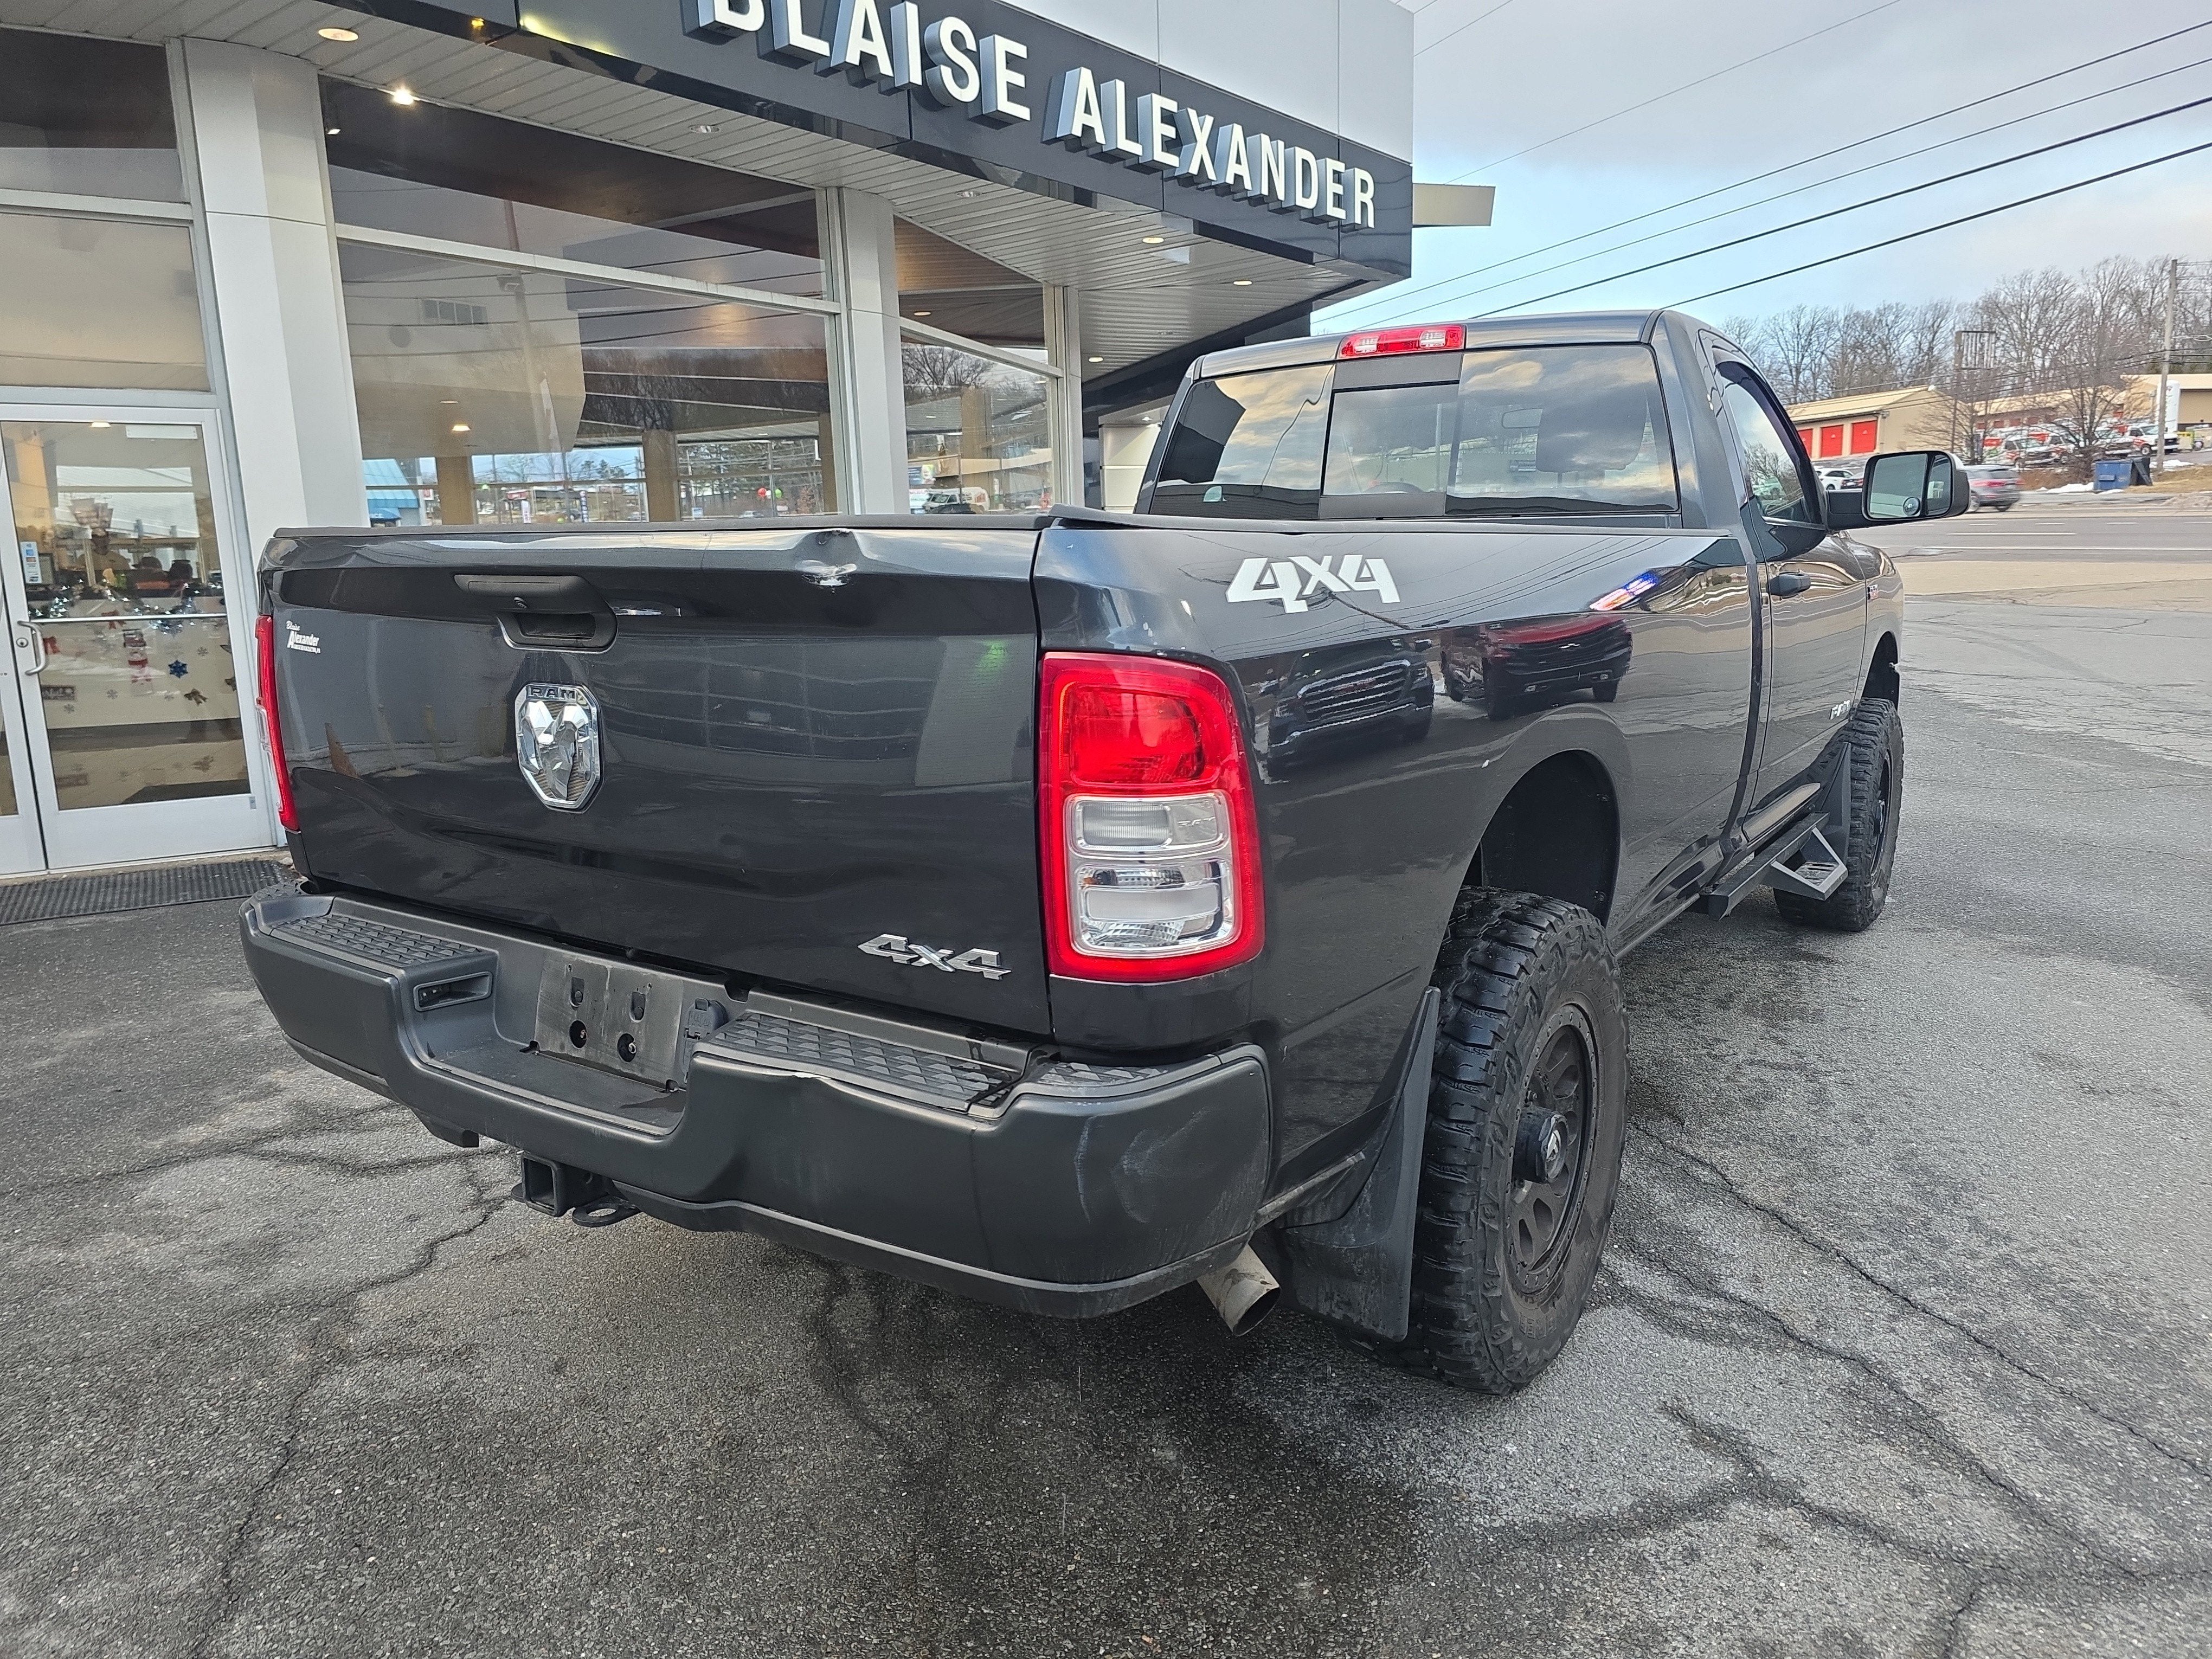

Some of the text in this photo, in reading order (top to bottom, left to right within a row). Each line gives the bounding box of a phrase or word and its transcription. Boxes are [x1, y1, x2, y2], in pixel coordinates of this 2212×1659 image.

[1057, 66, 1375, 229] ALEXANDER
[286, 631, 320, 648] Alexander
[528, 687, 576, 700] RAM
